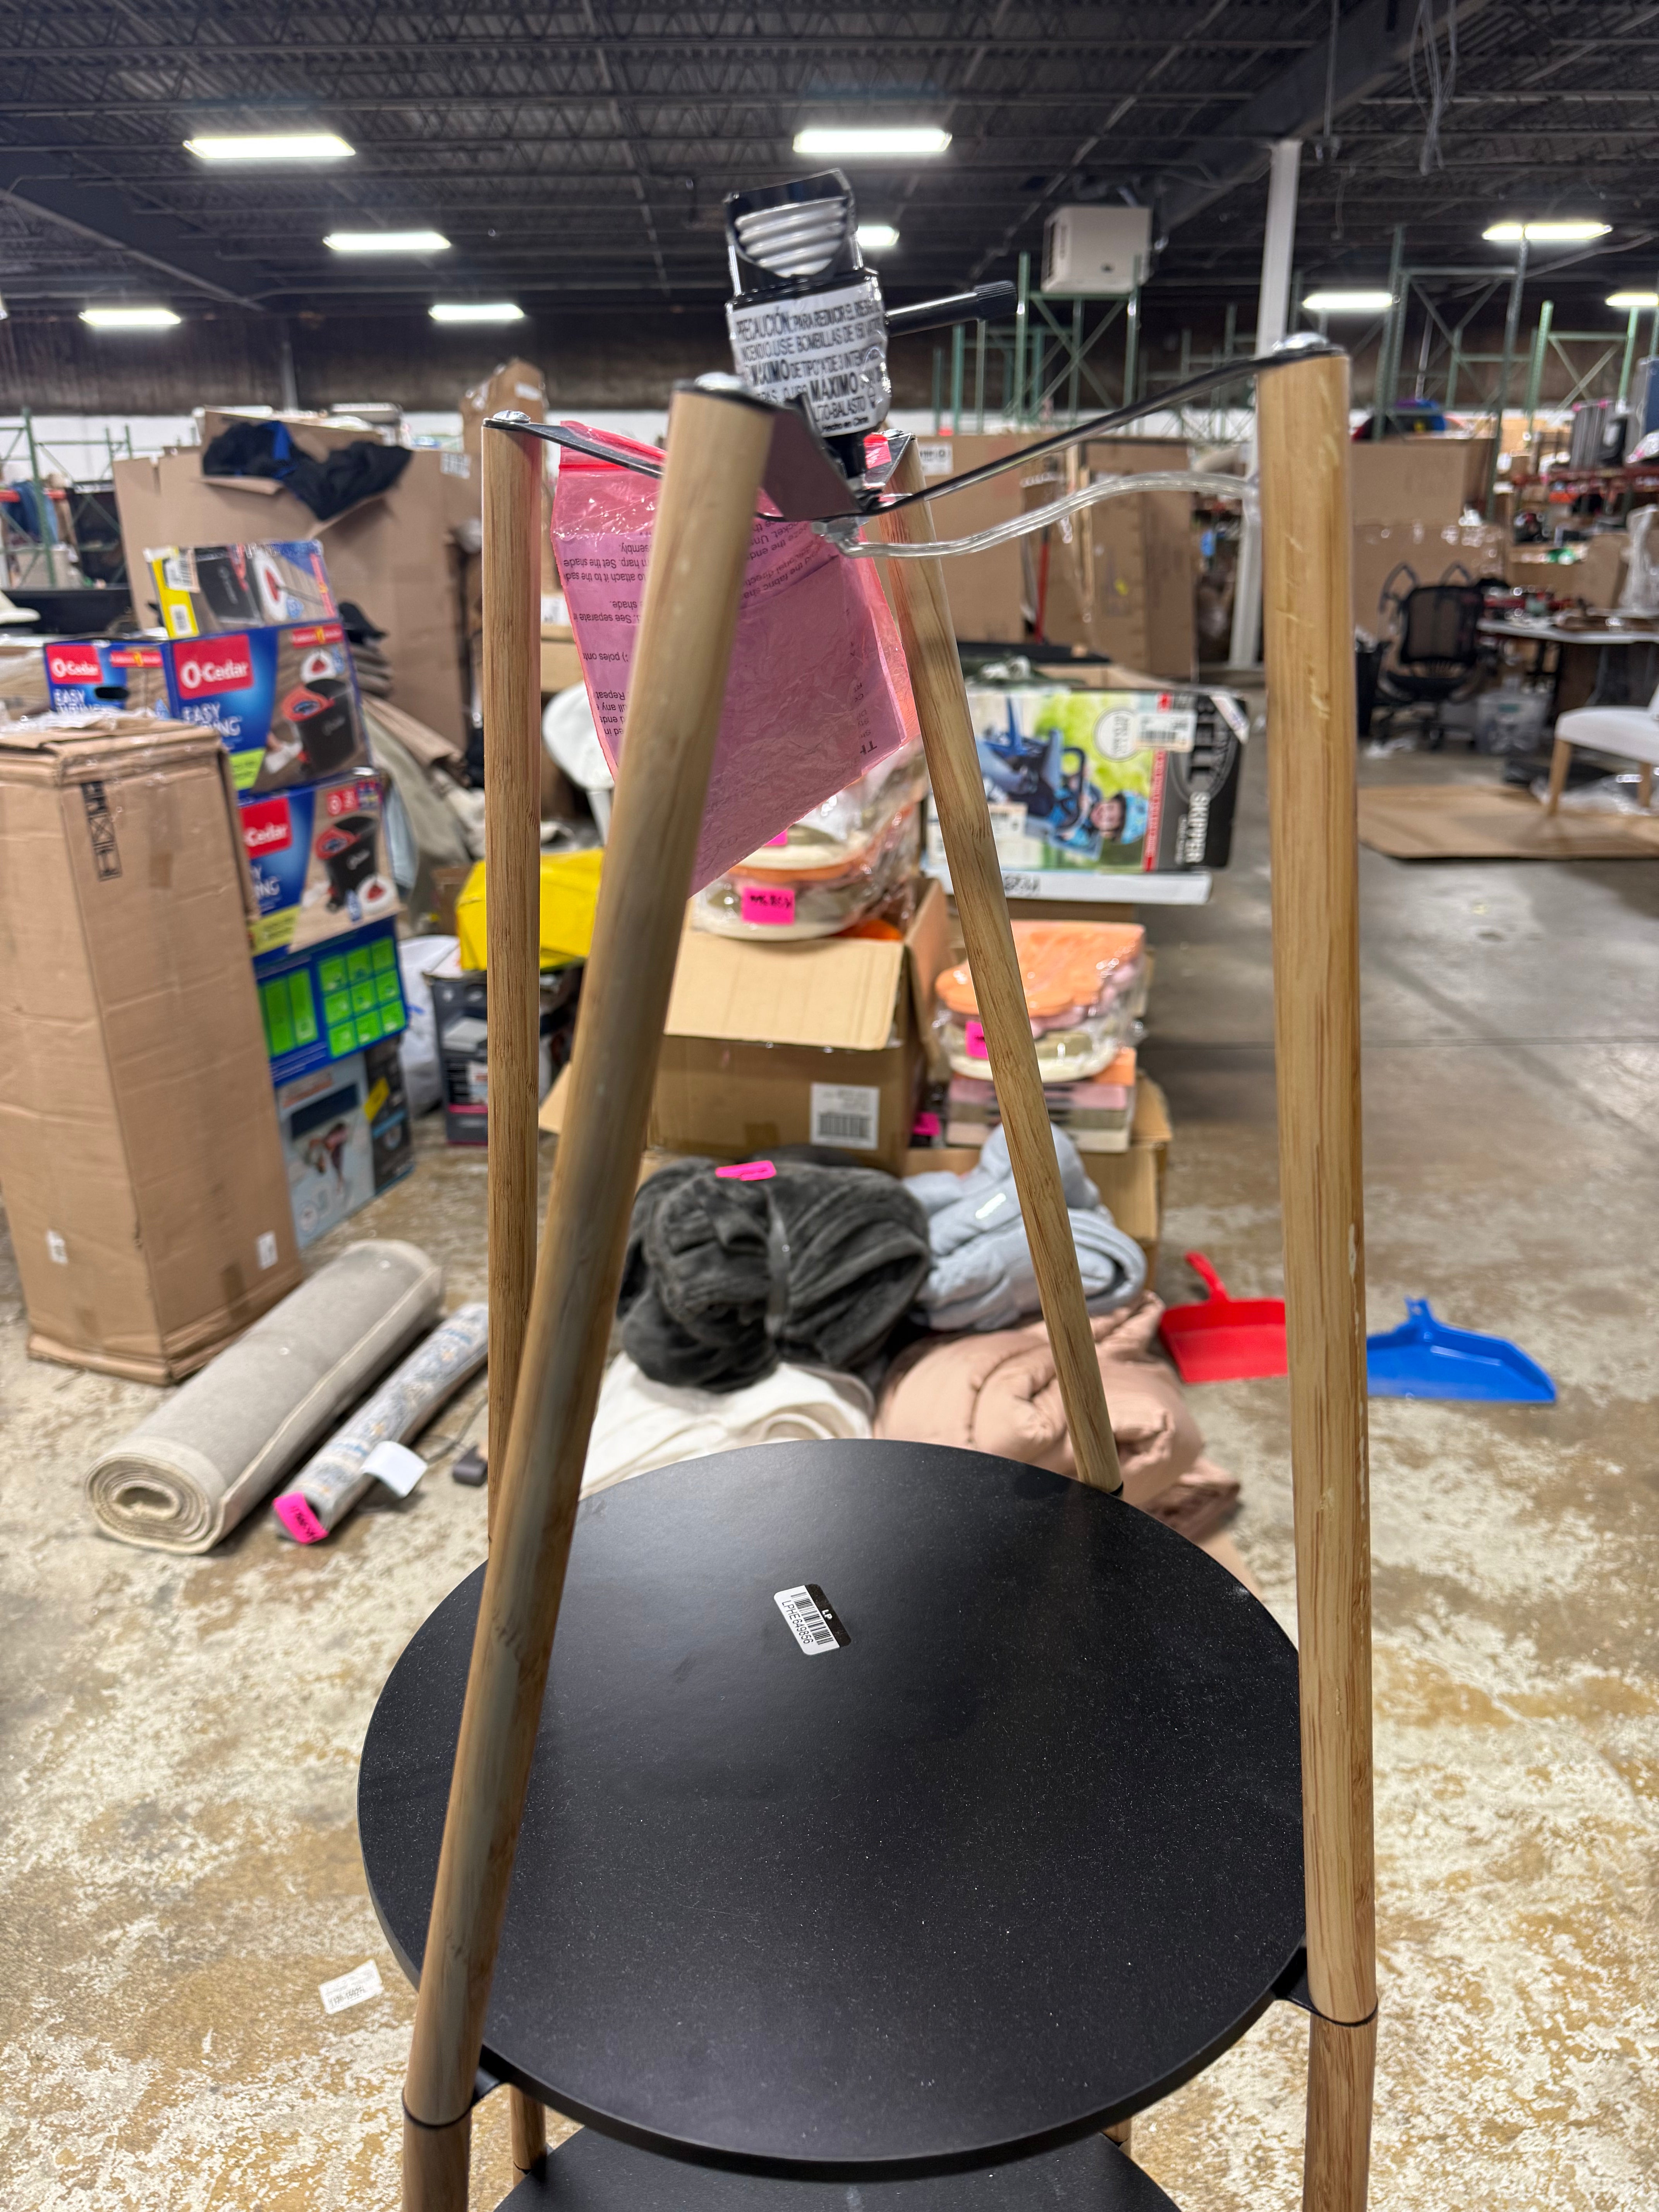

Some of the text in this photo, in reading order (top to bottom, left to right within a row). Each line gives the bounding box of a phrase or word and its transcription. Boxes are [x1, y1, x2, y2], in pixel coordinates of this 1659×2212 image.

[772, 337, 795, 358] USE
[796, 325, 842, 353] BOMBILLAS
[810, 371, 858, 403] MÁXIMO
[812, 395, 866, 422] UTO-BALASTO
[563, 558, 588, 568] shade
[590, 558, 601, 568] the
[603, 558, 617, 569] Set
[618, 558, 640, 569] harp.
[789, 562, 804, 575] the
[581, 572, 592, 582] the
[594, 573, 603, 582] to
[603, 573, 609, 583] it
[610, 573, 635, 583] attach
[609, 601, 637, 611] shade.
[579, 613, 613, 623] separate
[614, 614, 632, 624] See
[599, 653, 620, 662] poles
[52, 658, 98, 678] O-Cedar
[180, 659, 249, 689] O-Cedar
[54, 689, 86, 704] EASY
[595, 689, 626, 701] Repeat
[602, 702, 617, 711] any
[604, 728, 612, 737] in
[821, 1609, 833, 1620] LP
[782, 1600, 814, 1644] LPHE649856
